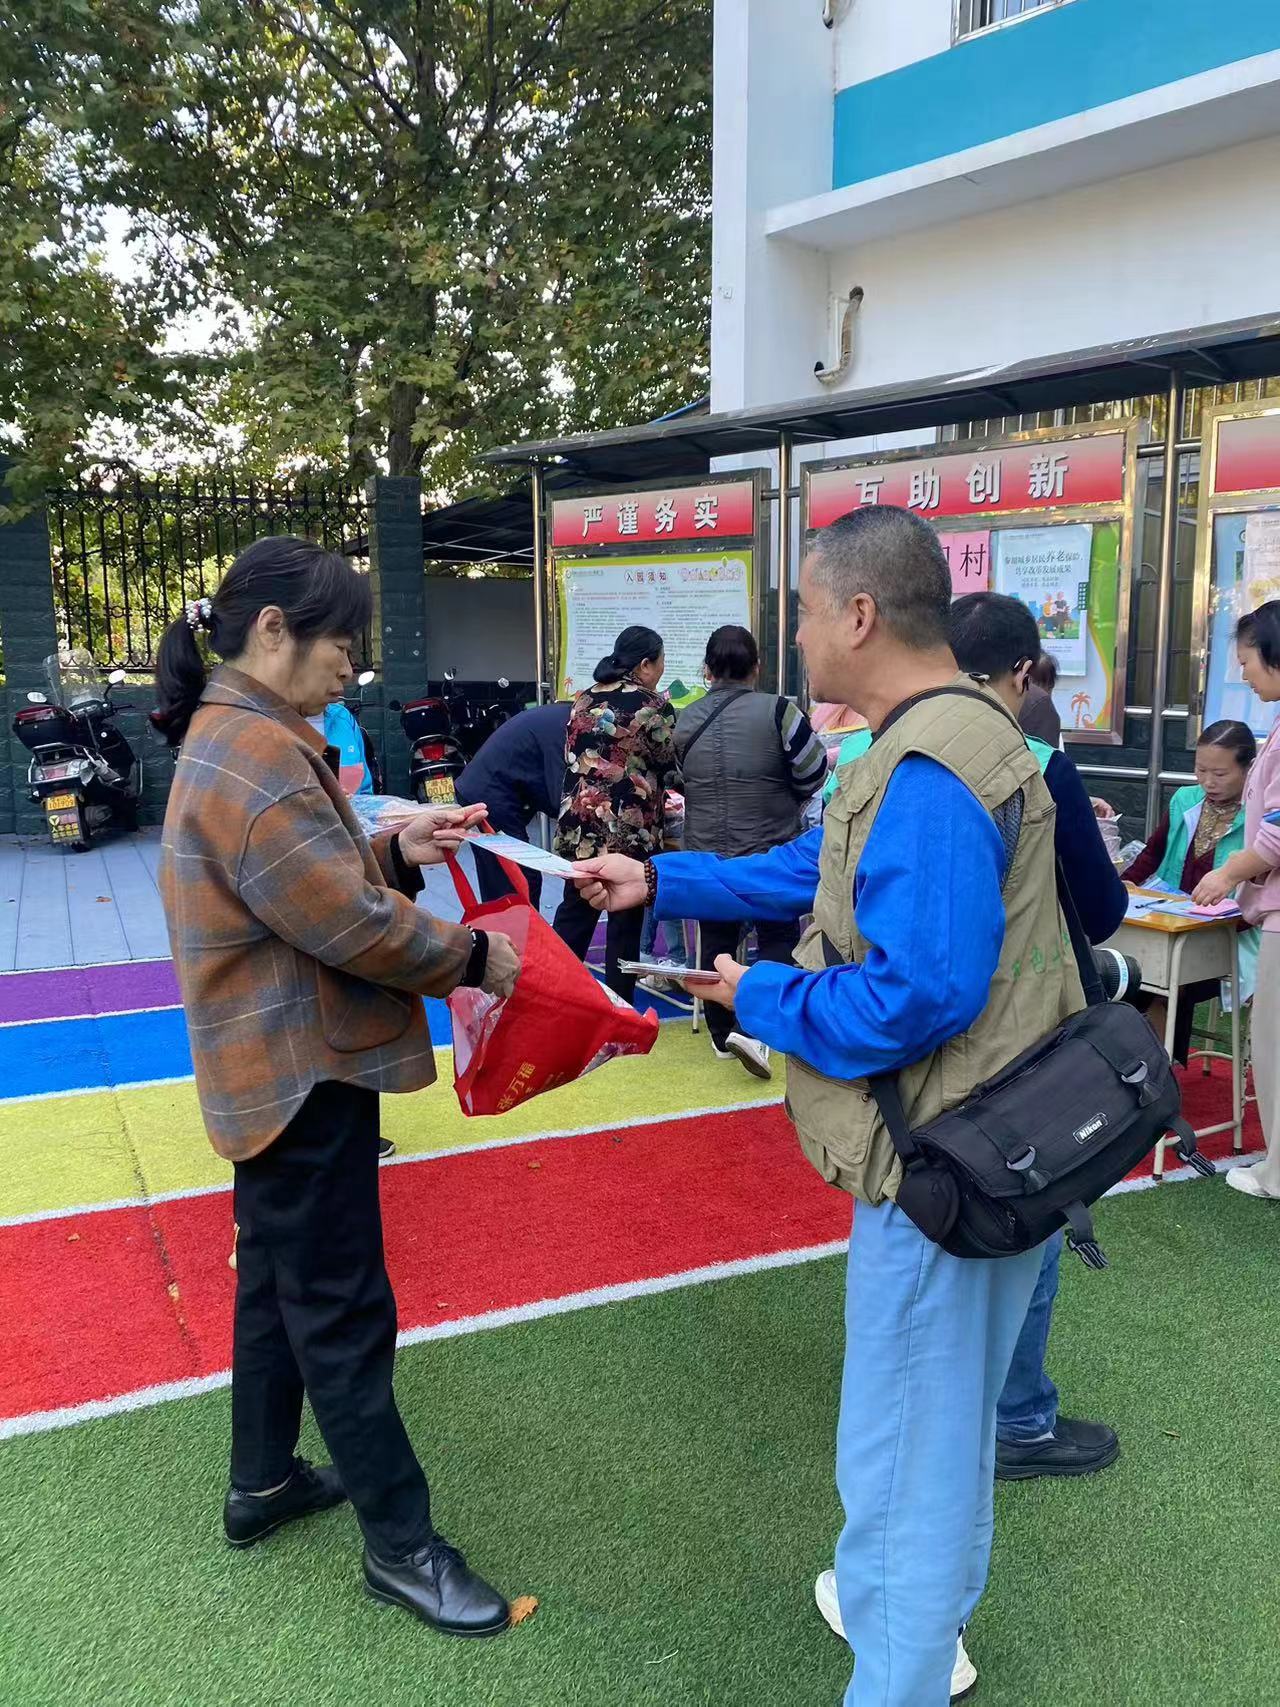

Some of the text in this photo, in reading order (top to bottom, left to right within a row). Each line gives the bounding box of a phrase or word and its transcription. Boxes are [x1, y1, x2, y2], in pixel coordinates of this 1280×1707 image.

[853, 453, 1069, 510] 互助创新
[581, 493, 719, 538] 严谨务实
[1079, 1119, 1103, 1140] Nikon
